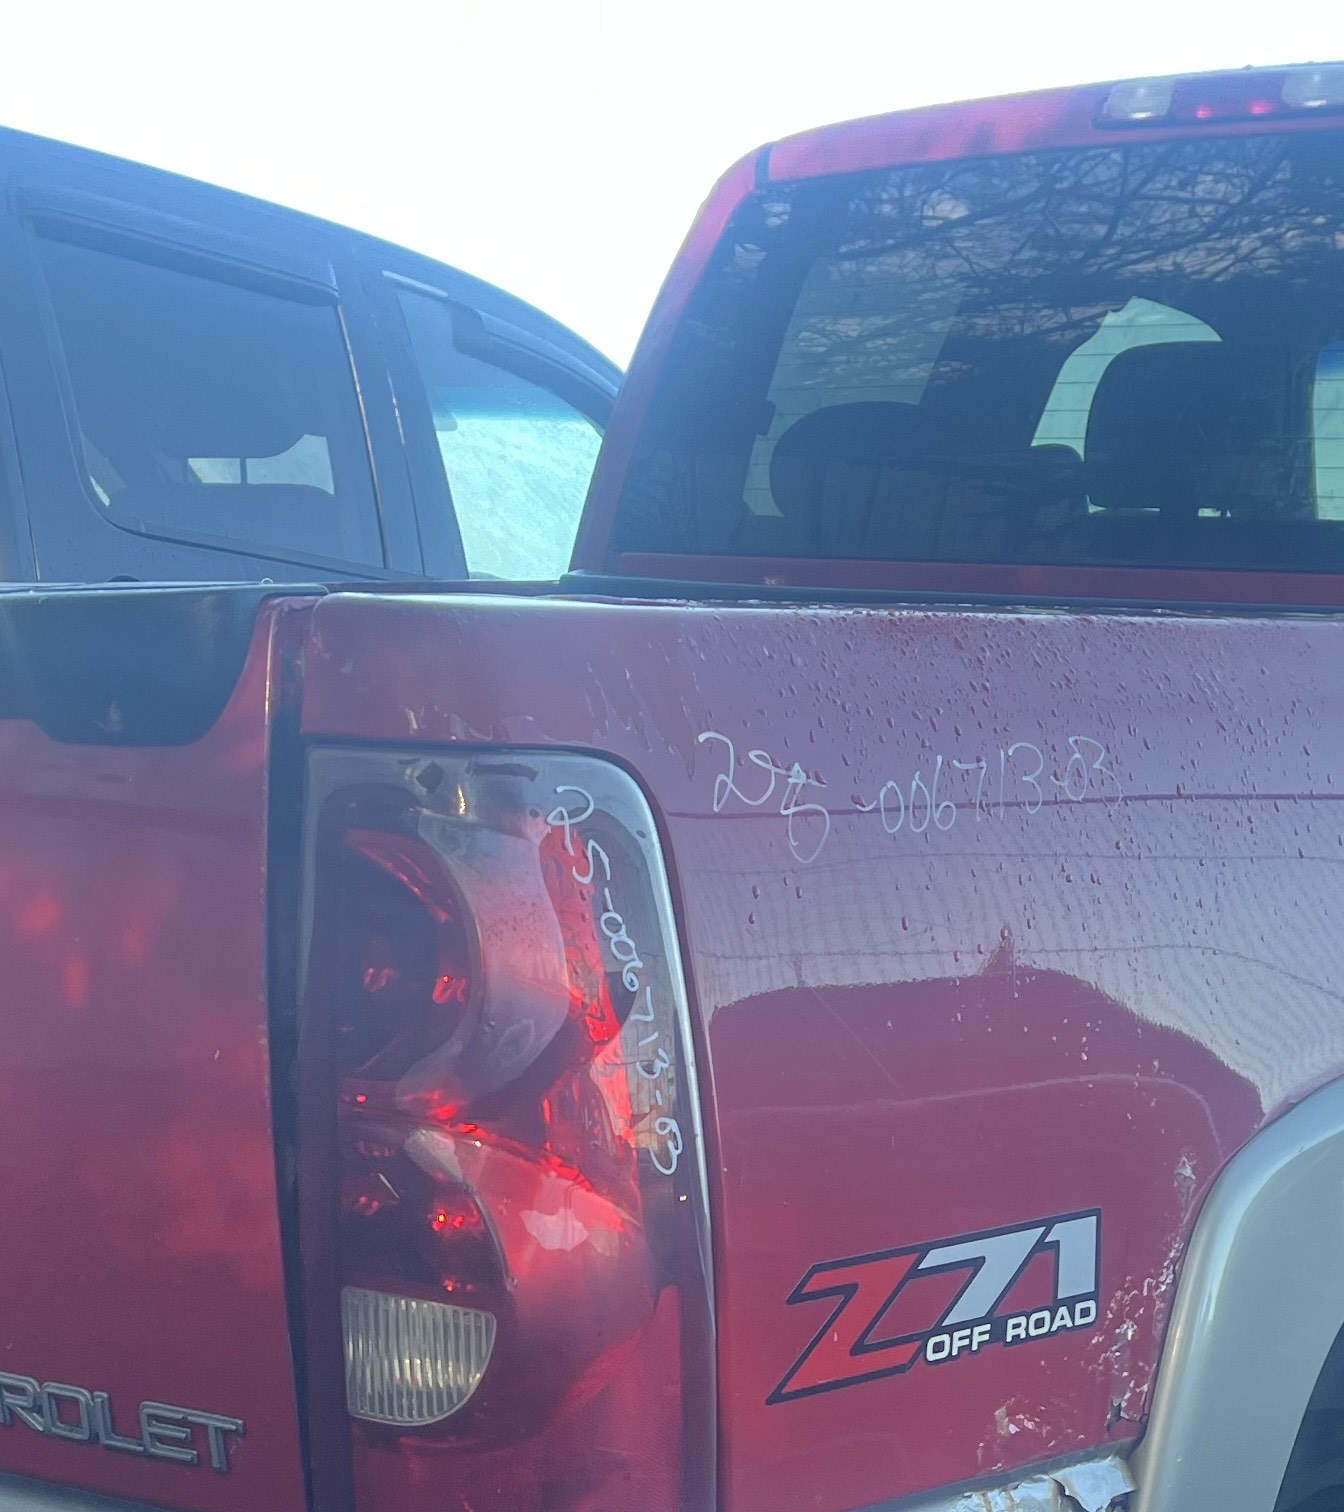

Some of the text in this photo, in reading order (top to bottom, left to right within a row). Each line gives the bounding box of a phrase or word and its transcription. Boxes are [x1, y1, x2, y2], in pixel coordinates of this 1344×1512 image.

[765, 1206, 1102, 1406] Z71
[925, 1298, 1098, 1363] OFF ROAD
